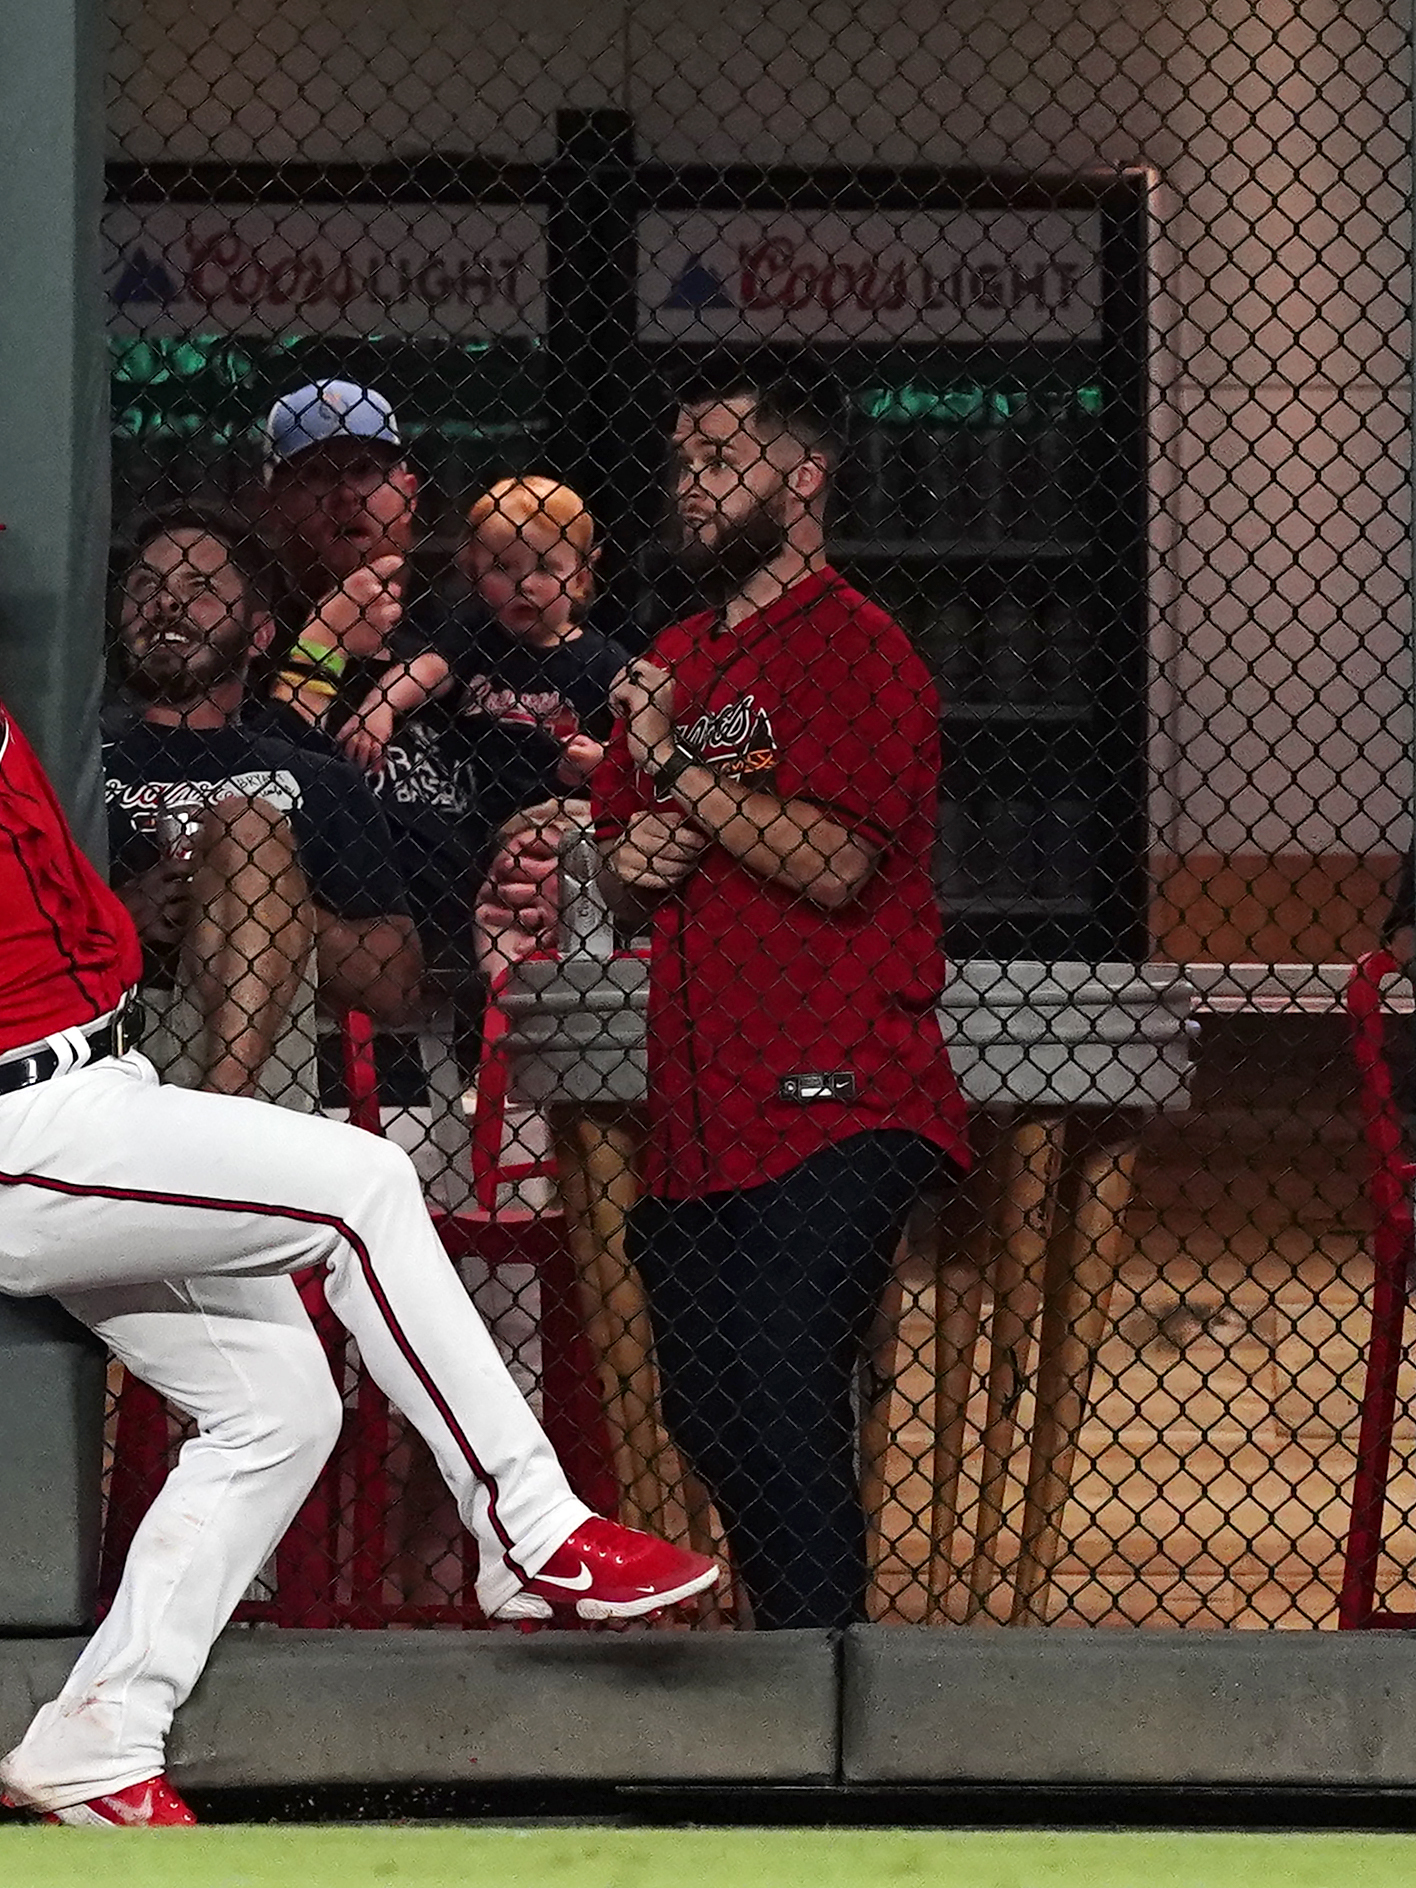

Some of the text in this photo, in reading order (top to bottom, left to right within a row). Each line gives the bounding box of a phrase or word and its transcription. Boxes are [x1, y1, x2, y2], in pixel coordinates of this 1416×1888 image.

[185, 231, 523, 304] Coors LIGHT
[740, 234, 1079, 311] Coors LIGHT
